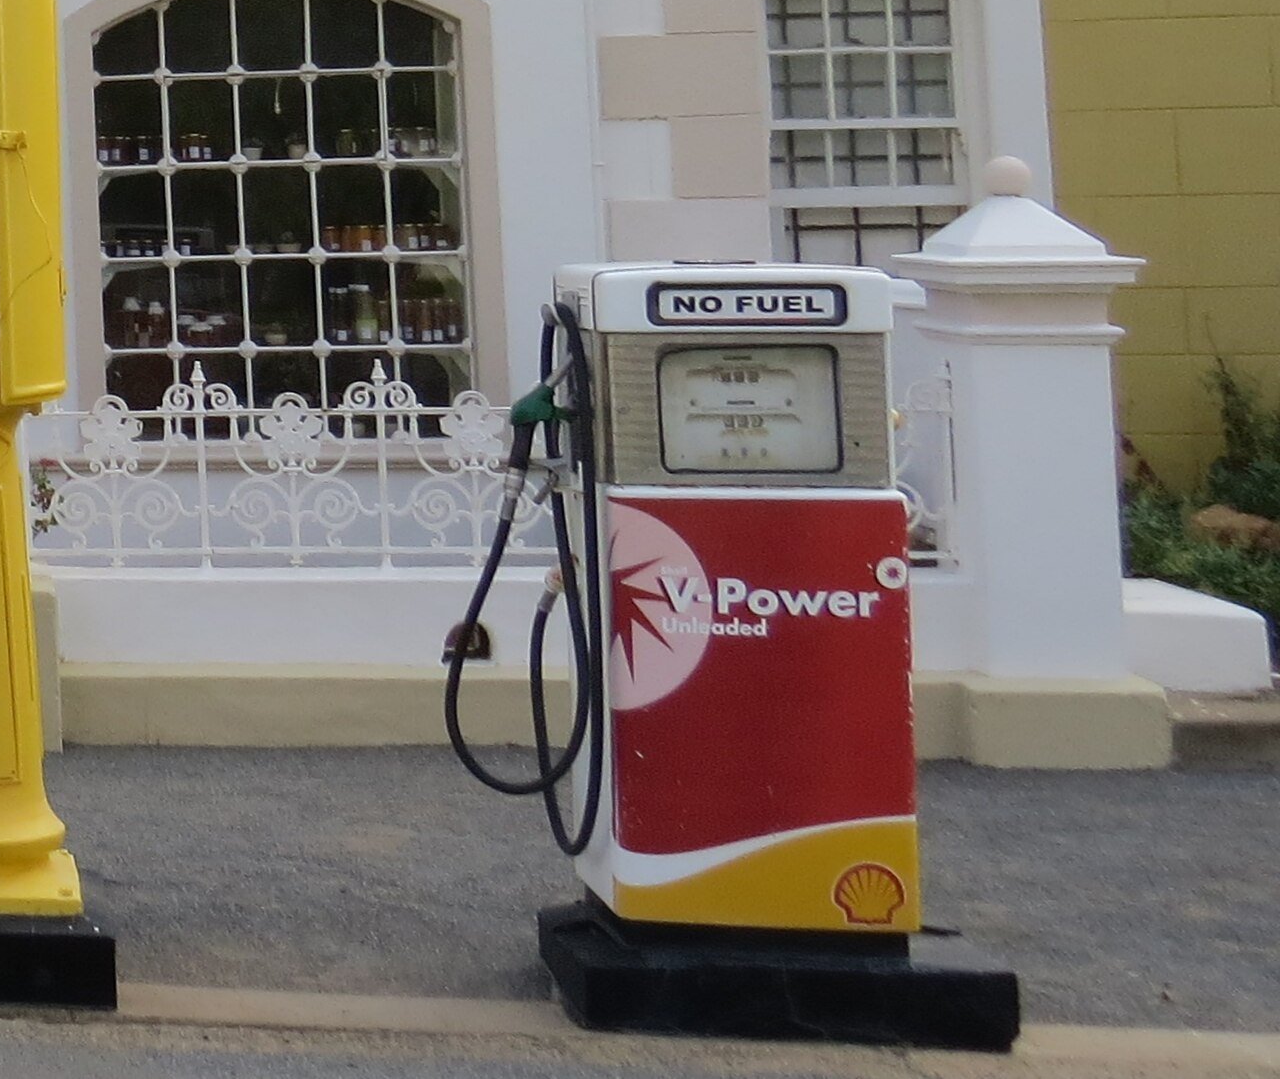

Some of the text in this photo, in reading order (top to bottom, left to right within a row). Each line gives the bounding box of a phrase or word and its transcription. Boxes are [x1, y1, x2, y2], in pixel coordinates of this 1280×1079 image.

[672, 296, 824, 313] NO FUEL
[659, 576, 880, 618] V-Power
